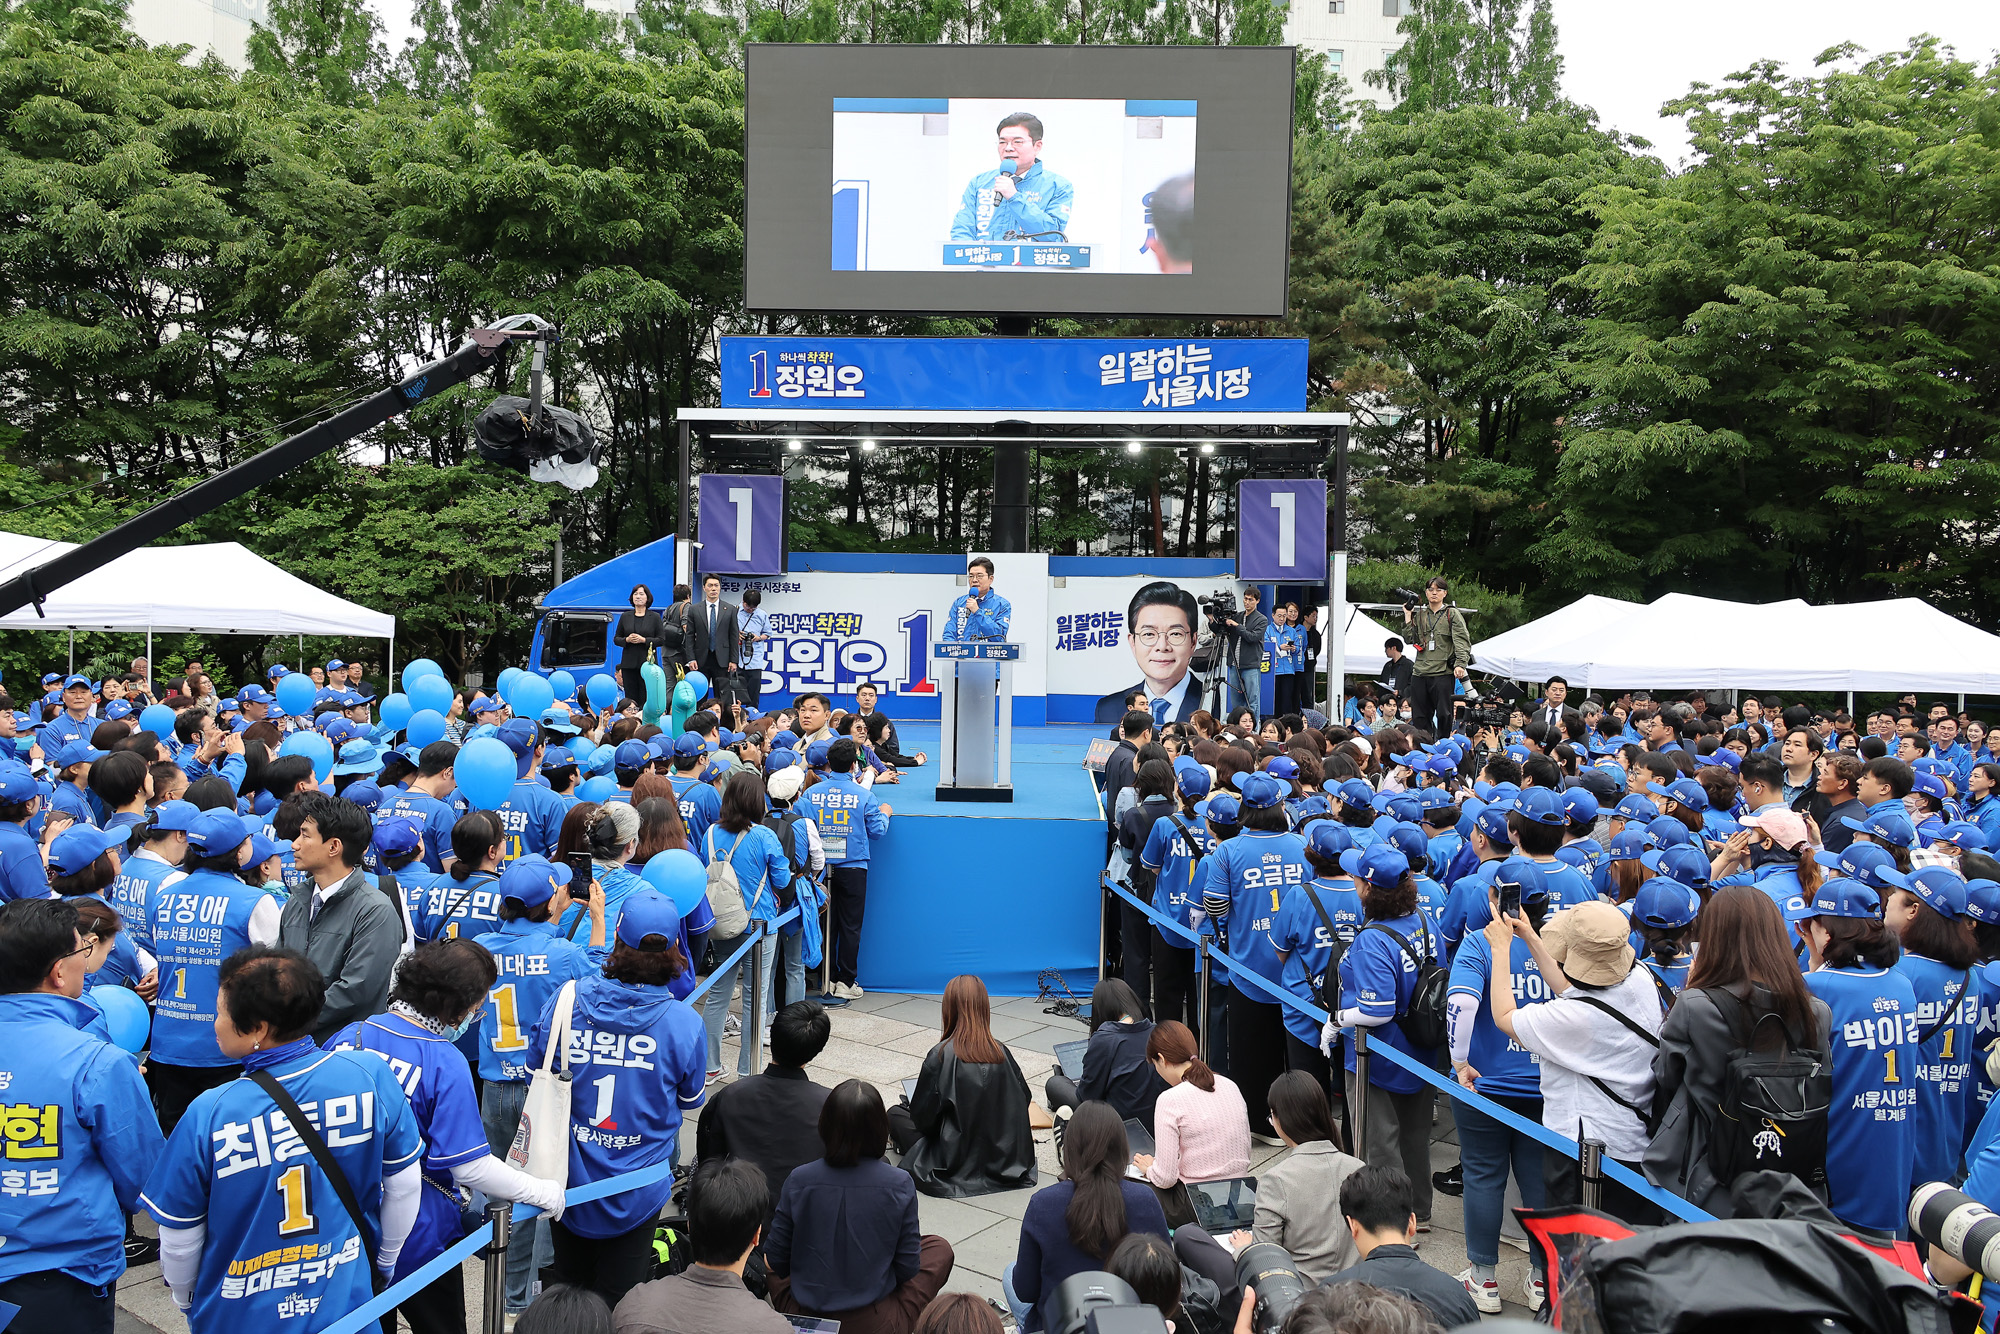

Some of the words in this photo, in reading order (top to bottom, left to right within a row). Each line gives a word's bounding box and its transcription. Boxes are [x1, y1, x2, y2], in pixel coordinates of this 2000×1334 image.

[1011, 246, 1022, 265] 1
[1034, 253, 1071, 265] 정원오
[780, 352, 806, 363] 하나씩
[807, 351, 834, 364] 착착!
[1098, 352, 1126, 386] 일
[1129, 343, 1213, 382] 잘하는
[749, 351, 772, 398] 1
[775, 365, 865, 398] 정원오
[1141, 366, 1252, 408] 서울시장
[728, 487, 753, 561] 1
[1270, 492, 1296, 567] 1
[770, 613, 815, 633] 하나씩
[816, 613, 862, 636] 착착!
[1056, 615, 1073, 633] 일
[1075, 611, 1124, 629] 잘하는
[896, 609, 938, 697] 1
[1055, 629, 1120, 651] 서울시장
[811, 793, 859, 809] 박영화
[817, 808, 851, 825] 1-다
[496, 810, 529, 832] 영화
[1243, 863, 1304, 890] 오금란
[1914, 880, 1933, 897] 박이강
[157, 893, 230, 926] 김정애
[427, 887, 502, 922] 최동민
[1269, 888, 1280, 912] 1
[169, 926, 222, 944] 서울시의원
[174, 967, 187, 999] 1
[488, 983, 529, 1052] 1
[1872, 999, 1900, 1013] 민주당
[1843, 1011, 1919, 1051] 박이강
[1938, 1028, 1954, 1059] 1
[567, 1029, 657, 1071] 정원오
[1883, 1049, 1900, 1083] 1
[588, 1073, 618, 1131] 1
[1851, 1088, 1917, 1110] 서울시의원
[1874, 1108, 1907, 1122] 월계동
[212, 1091, 376, 1180] 최동민
[1, 1167, 60, 1198] 후보
[276, 1164, 319, 1239] 1
[227, 1242, 333, 1276] 이재명정부의
